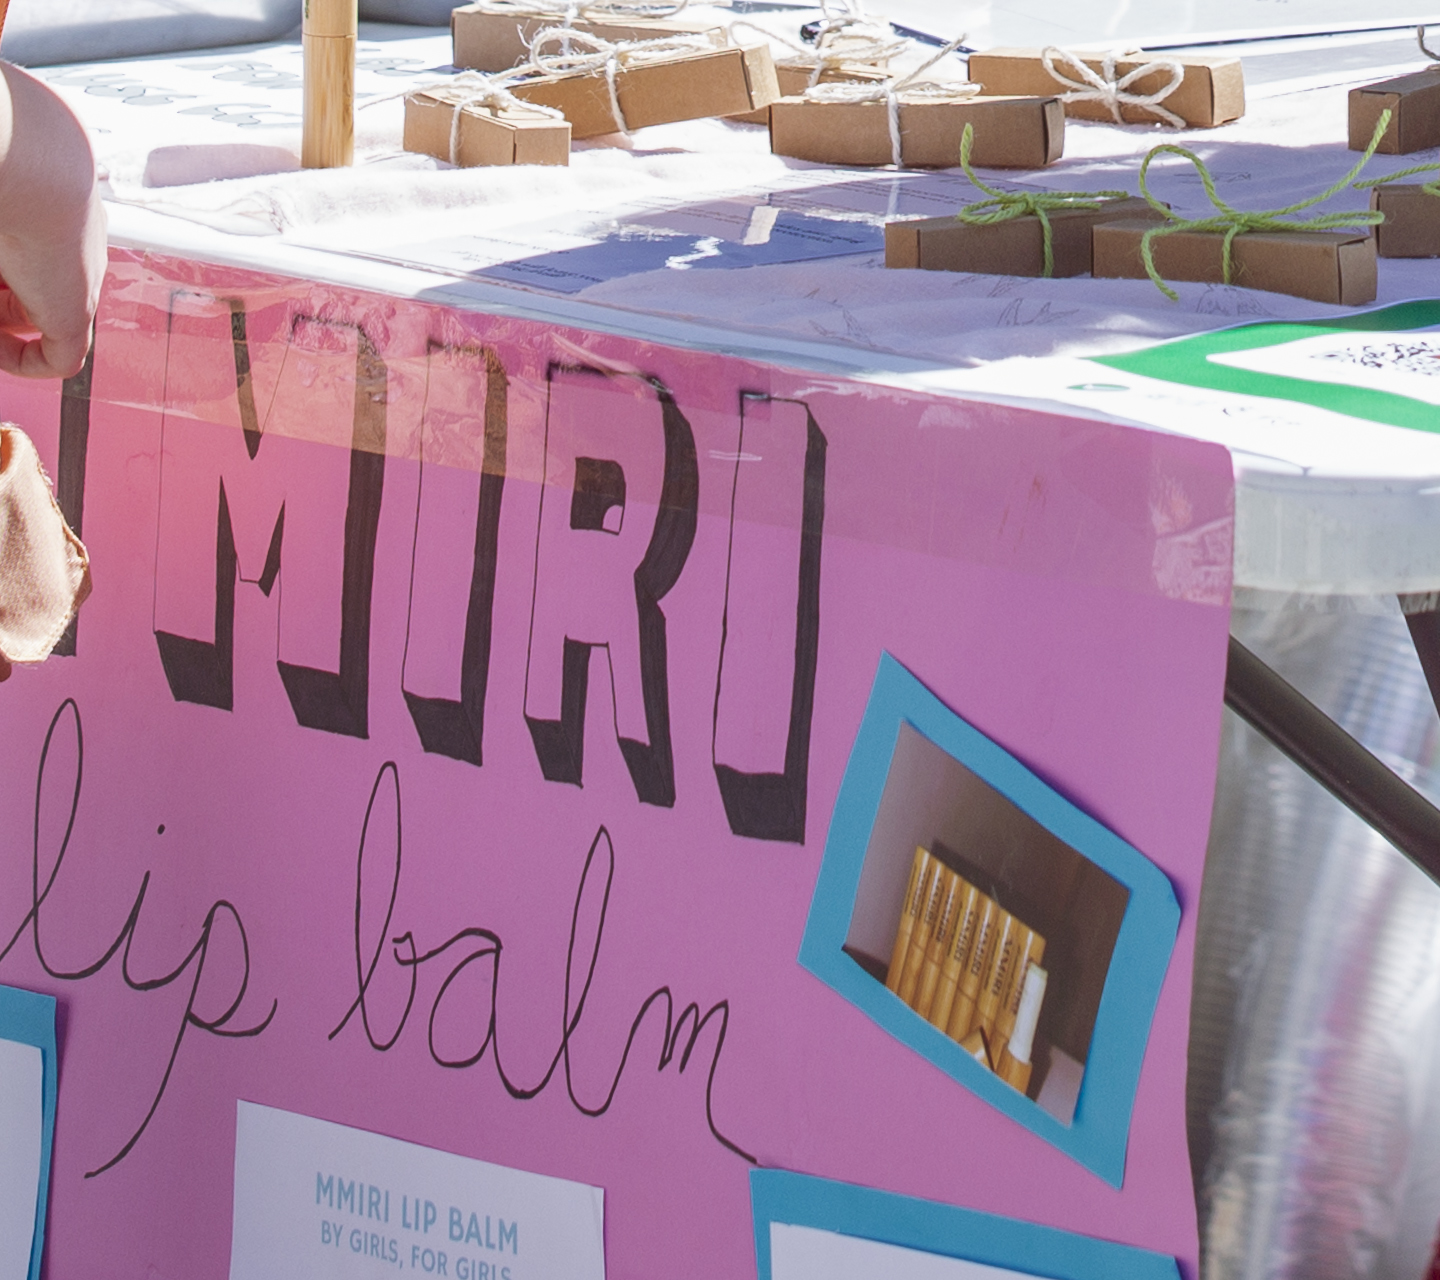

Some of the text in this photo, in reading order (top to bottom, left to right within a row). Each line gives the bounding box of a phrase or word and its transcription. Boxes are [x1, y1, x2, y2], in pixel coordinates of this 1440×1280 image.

[51, 287, 829, 846] MIRI
[329, 761, 761, 1168] balm
[315, 1171, 519, 1255] MMIRI LIP BALM
[321, 1220, 344, 1248] BY
[349, 1228, 404, 1270] GIRLS,
[411, 1244, 449, 1276] FOR
